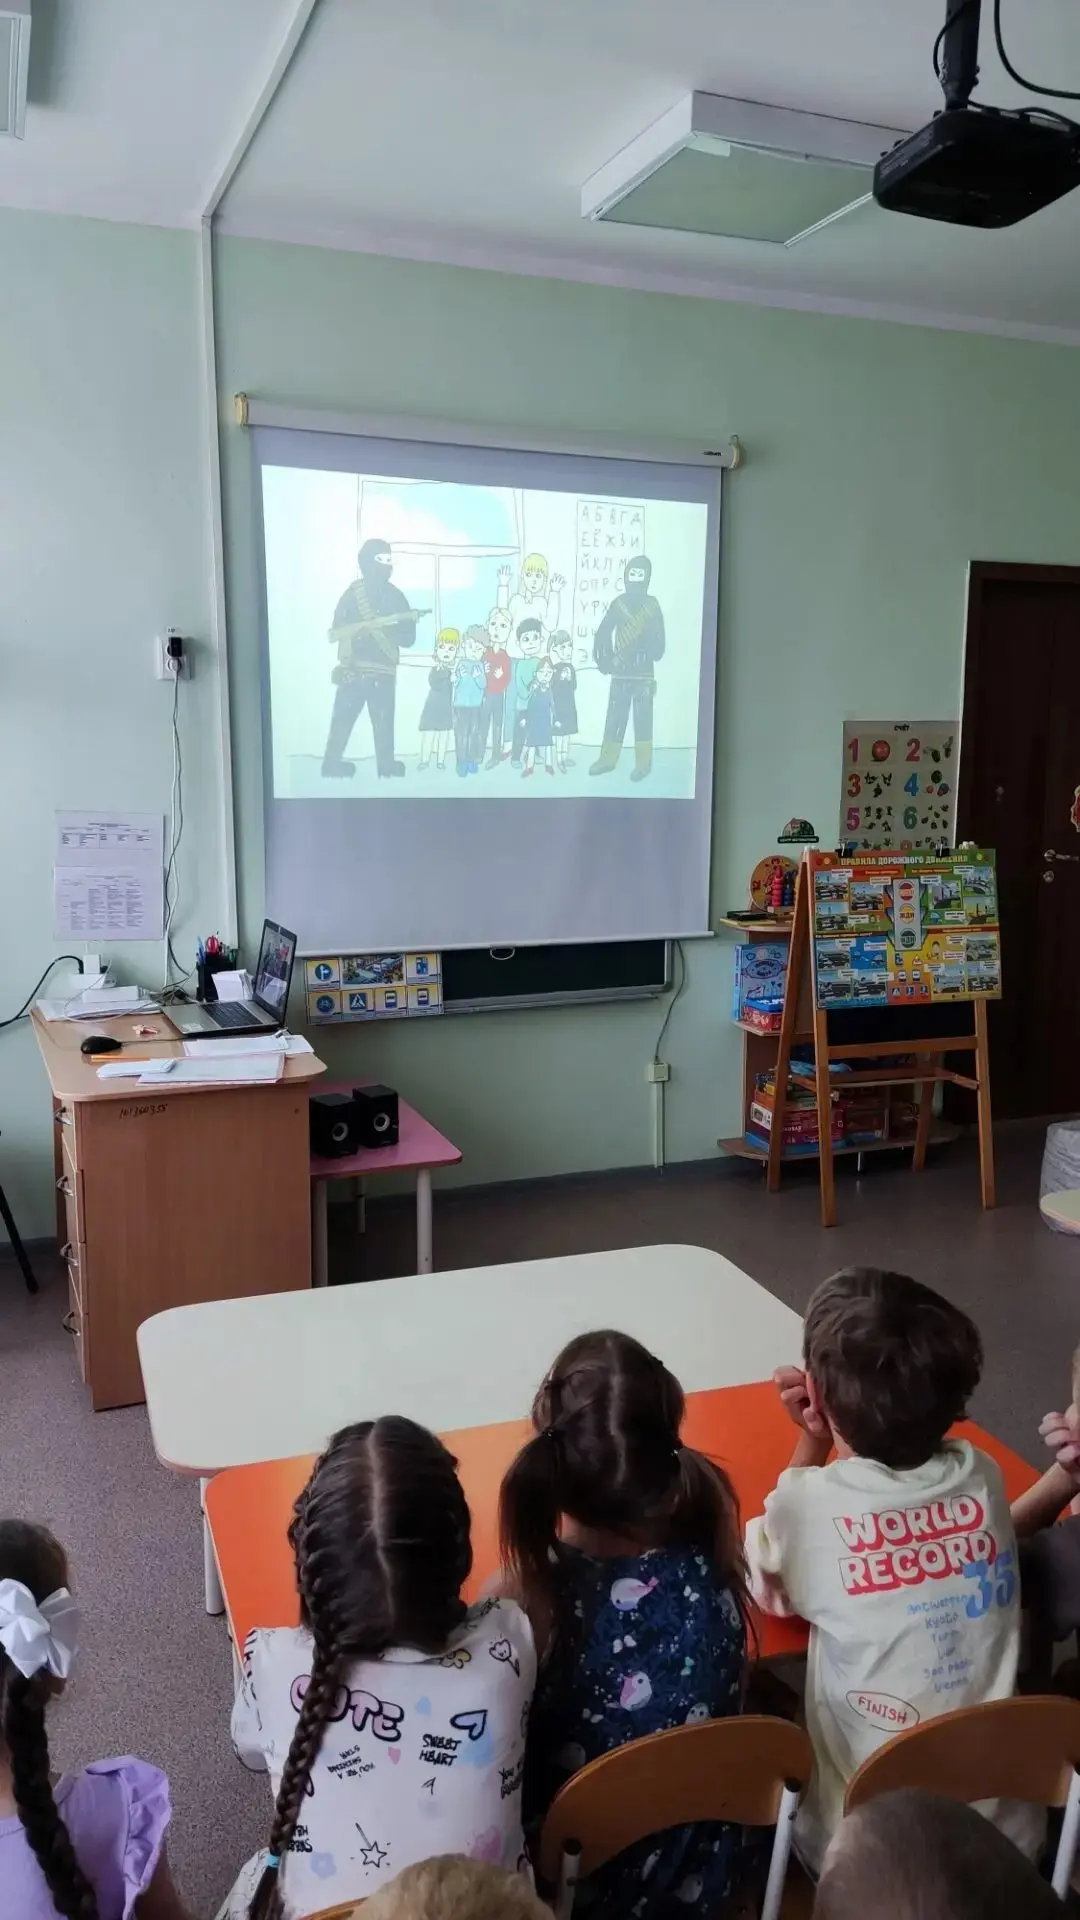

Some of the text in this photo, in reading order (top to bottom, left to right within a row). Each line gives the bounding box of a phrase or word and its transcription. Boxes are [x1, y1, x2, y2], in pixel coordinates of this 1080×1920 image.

[848, 738, 921, 762] 1 2
[847, 772, 919, 798] 3 4
[846, 806, 918, 831] 5 6
[833, 1494, 984, 1553] WORLD
[838, 1530, 997, 1596] RECORD
[857, 1695, 908, 1725] FINISH
[422, 1733, 463, 1752] SWEET
[418, 1750, 458, 1767] HEART
